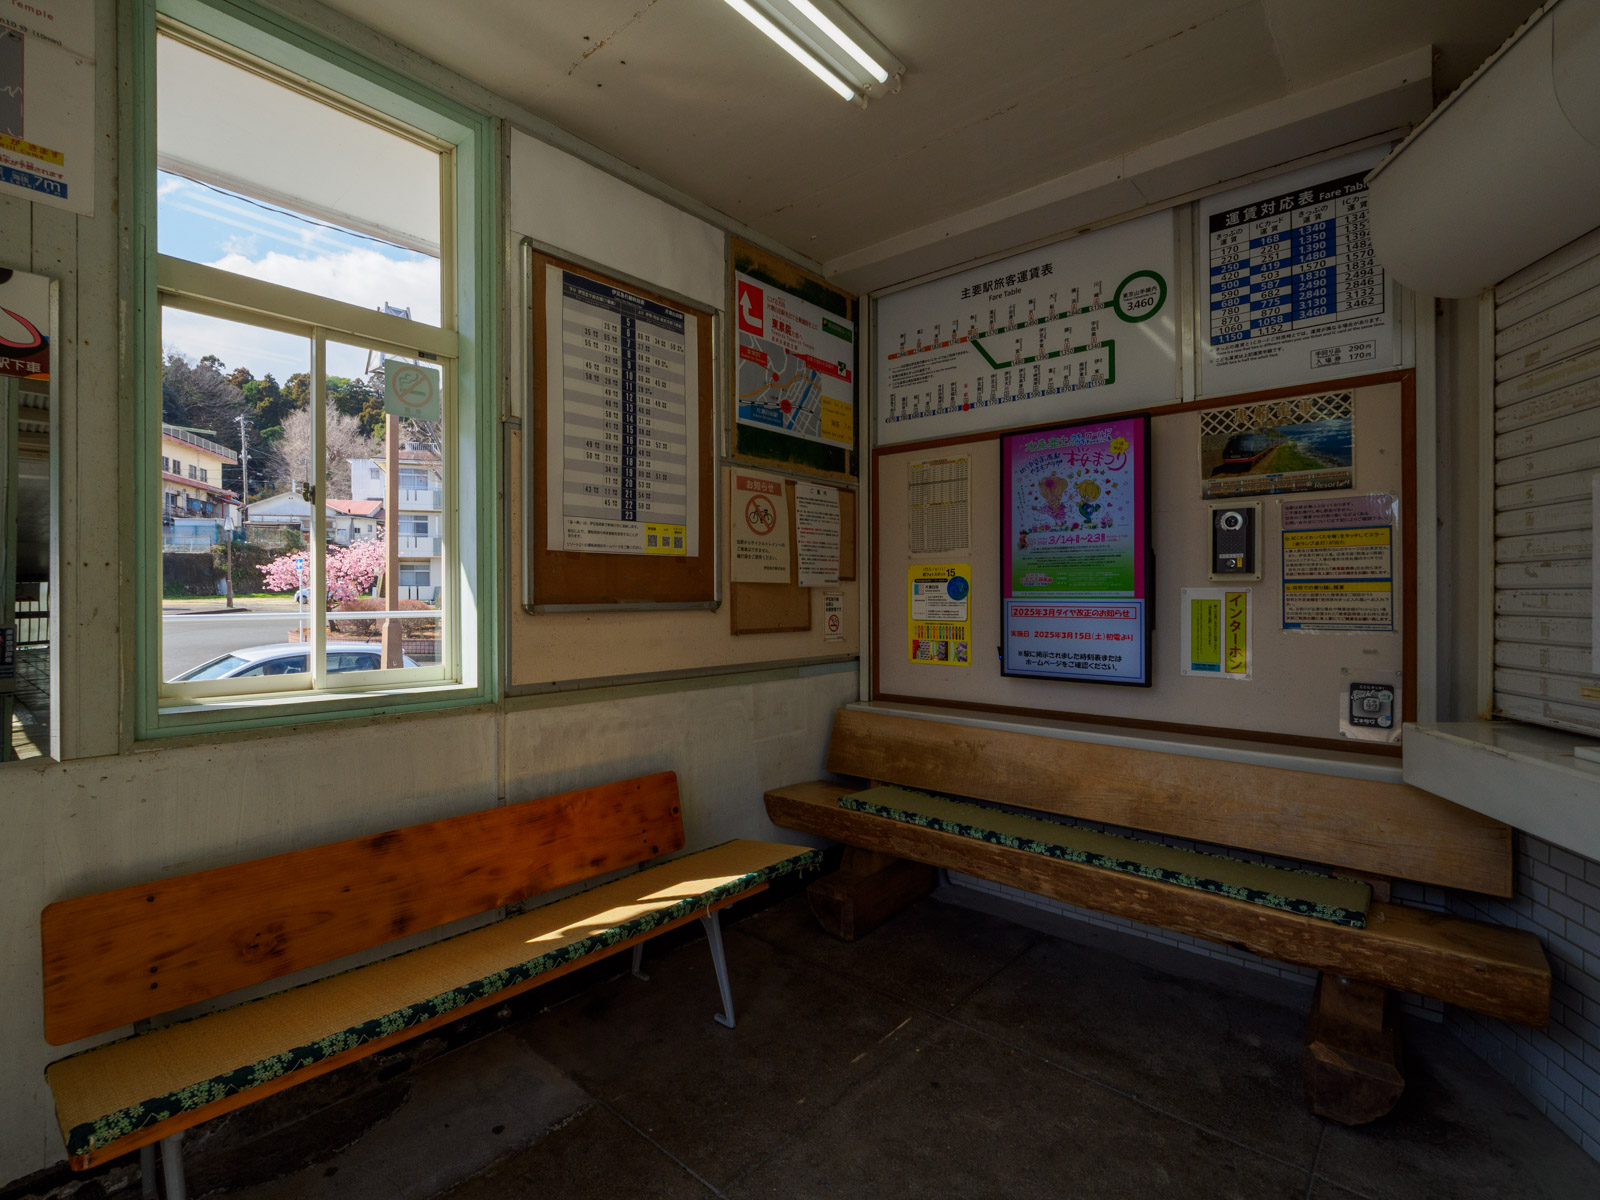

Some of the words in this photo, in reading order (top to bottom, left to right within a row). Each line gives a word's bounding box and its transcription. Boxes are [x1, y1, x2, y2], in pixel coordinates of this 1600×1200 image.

[1225, 190, 1314, 226] 運賃対応表
[1319, 189, 1342, 200] Fare
[1299, 204, 1328, 218] きっぷの
[1345, 211, 1370, 224] 1,34
[1299, 222, 1326, 236] 1,340
[1345, 220, 1370, 233] 1,35
[1217, 228, 1243, 240] きっぷの
[1299, 231, 1326, 245] 1,350
[1261, 234, 1280, 245] 168
[1221, 245, 1240, 255] 170
[1261, 244, 1280, 254] 220
[1299, 241, 1326, 254] 1,390
[1221, 254, 1240, 264] 220
[1261, 252, 1280, 262] 251
[1299, 250, 1326, 263] 1,480
[1221, 263, 1240, 273] 250
[1261, 261, 1280, 271] 419
[1299, 260, 1326, 272] 1,570
[1221, 272, 1240, 281] 420
[1261, 271, 1280, 281] 503
[1299, 269, 1326, 282] 1,830
[961, 263, 1053, 300] 主要駅旅客運賃表
[1221, 280, 1240, 290] 500
[1261, 280, 1280, 290] 587
[1299, 278, 1326, 291] 2,490
[988, 293, 1003, 302] Fare
[1004, 287, 1021, 297] Table
[1221, 289, 1240, 299] 590
[1261, 289, 1280, 299] 682
[1299, 287, 1326, 300] 2,840
[1127, 297, 1154, 311] 3,460
[1221, 298, 1240, 308] 680
[1261, 298, 1280, 308] 775
[1299, 297, 1326, 309] 3,130
[1221, 306, 1240, 316] 780
[1261, 306, 1280, 317] 870
[1299, 306, 1326, 318] 3,460
[1221, 315, 1240, 325] 870
[1258, 315, 1284, 327] 1,058
[1258, 324, 1283, 336] 1,152
[1218, 332, 1243, 343] 1,150
[625, 371, 633, 379] 10
[625, 382, 633, 391] 11
[625, 392, 634, 402] 12
[625, 403, 634, 412] 13
[625, 414, 634, 423] 14
[625, 425, 634, 434] 15
[625, 446, 634, 454] 17
[625, 456, 634, 465] 18
[1063, 447, 1127, 471] 桜まつり
[625, 467, 634, 476] 19
[625, 478, 634, 488] 20
[746, 480, 776, 493] お知らせ
[1314, 480, 1339, 490] Resort
[625, 489, 634, 499] 21
[625, 500, 634, 509] 22
[625, 511, 634, 520] 23
[1012, 607, 1130, 618] 2025年3月ダイヤ改正のお知らせ
[1010, 630, 1029, 638] 実施日
[1229, 594, 1243, 670] インターホン
[1025, 659, 1118, 672] ホームページをご確認ください。
